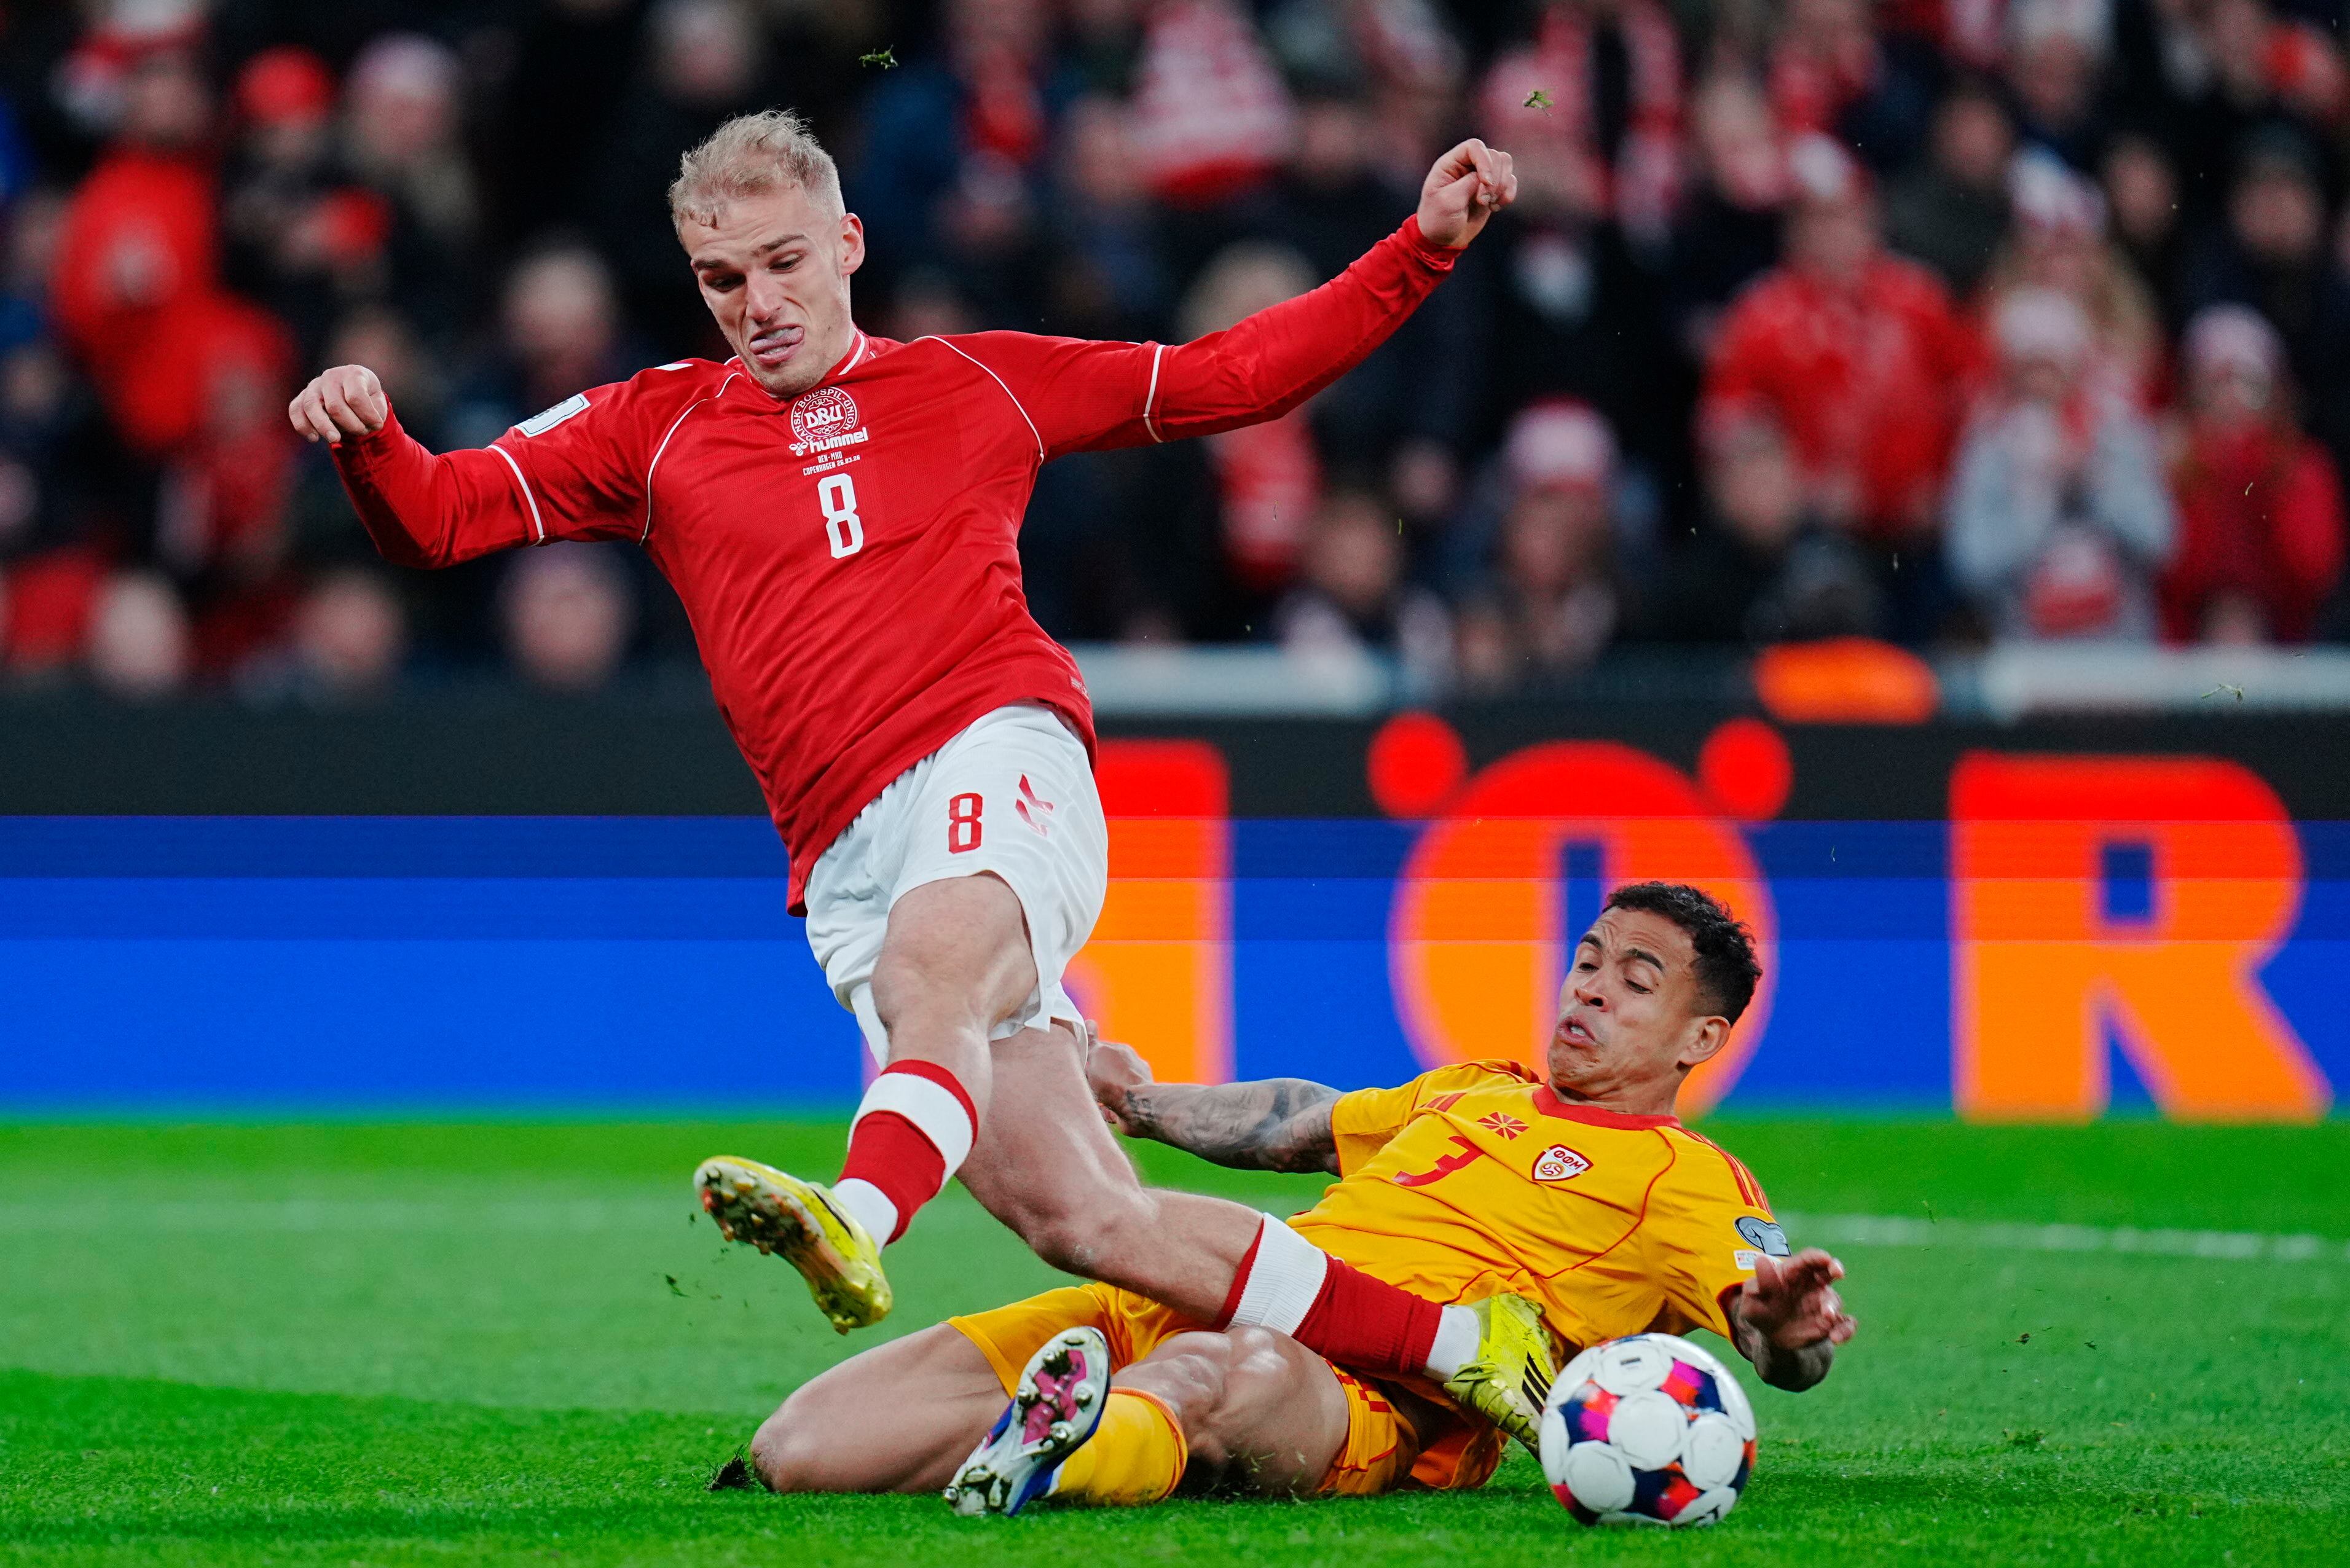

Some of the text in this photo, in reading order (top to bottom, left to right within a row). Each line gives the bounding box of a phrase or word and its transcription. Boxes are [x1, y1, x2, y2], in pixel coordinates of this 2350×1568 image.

[793, 410, 814, 442] DANSK
[804, 404, 844, 429] DBU
[809, 426, 869, 453] hummel
[803, 461, 836, 476] COPENHAGEN
[817, 472, 864, 559] 8
[948, 793, 983, 855] 8
[1554, 1150, 1585, 1170] ФФМ
